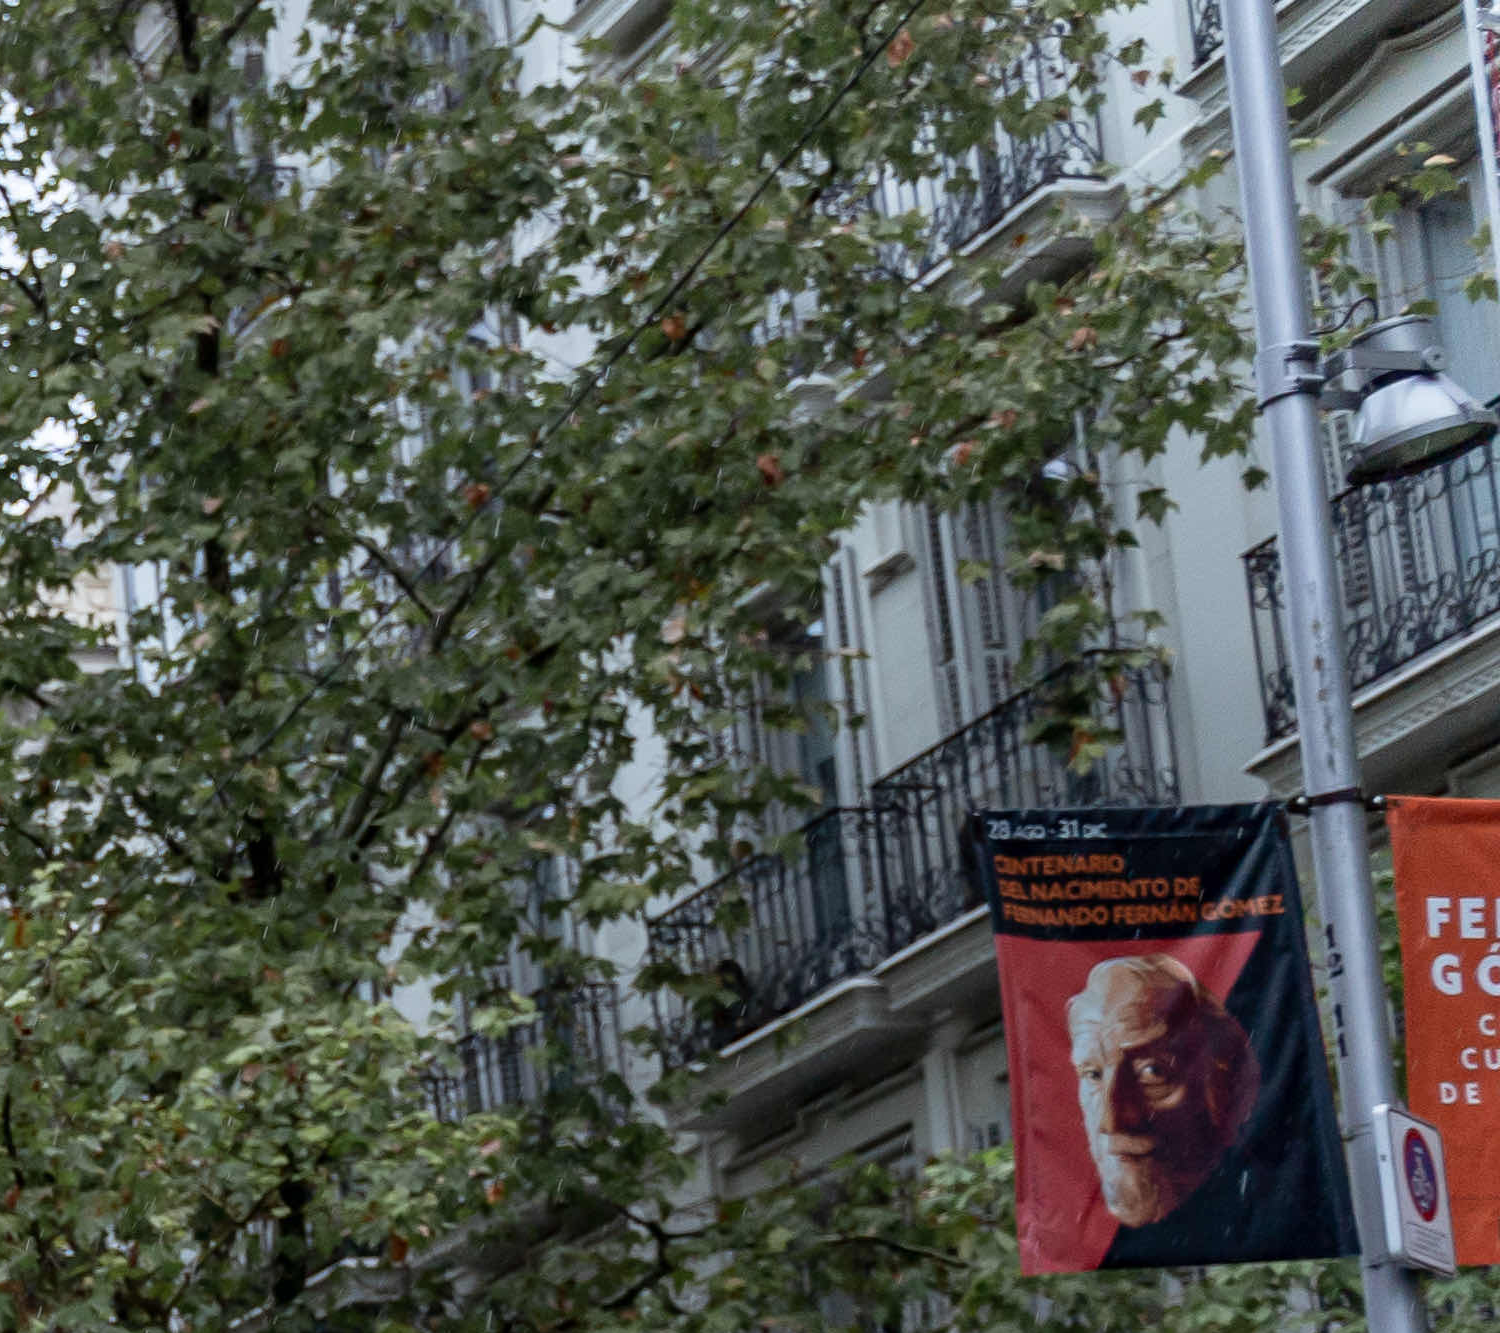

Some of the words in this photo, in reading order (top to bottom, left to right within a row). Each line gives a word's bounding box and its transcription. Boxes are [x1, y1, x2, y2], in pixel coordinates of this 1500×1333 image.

[1173, 876, 1200, 898] DE
[1425, 896, 1500, 940] FE
[1438, 1081, 1481, 1105] DE
